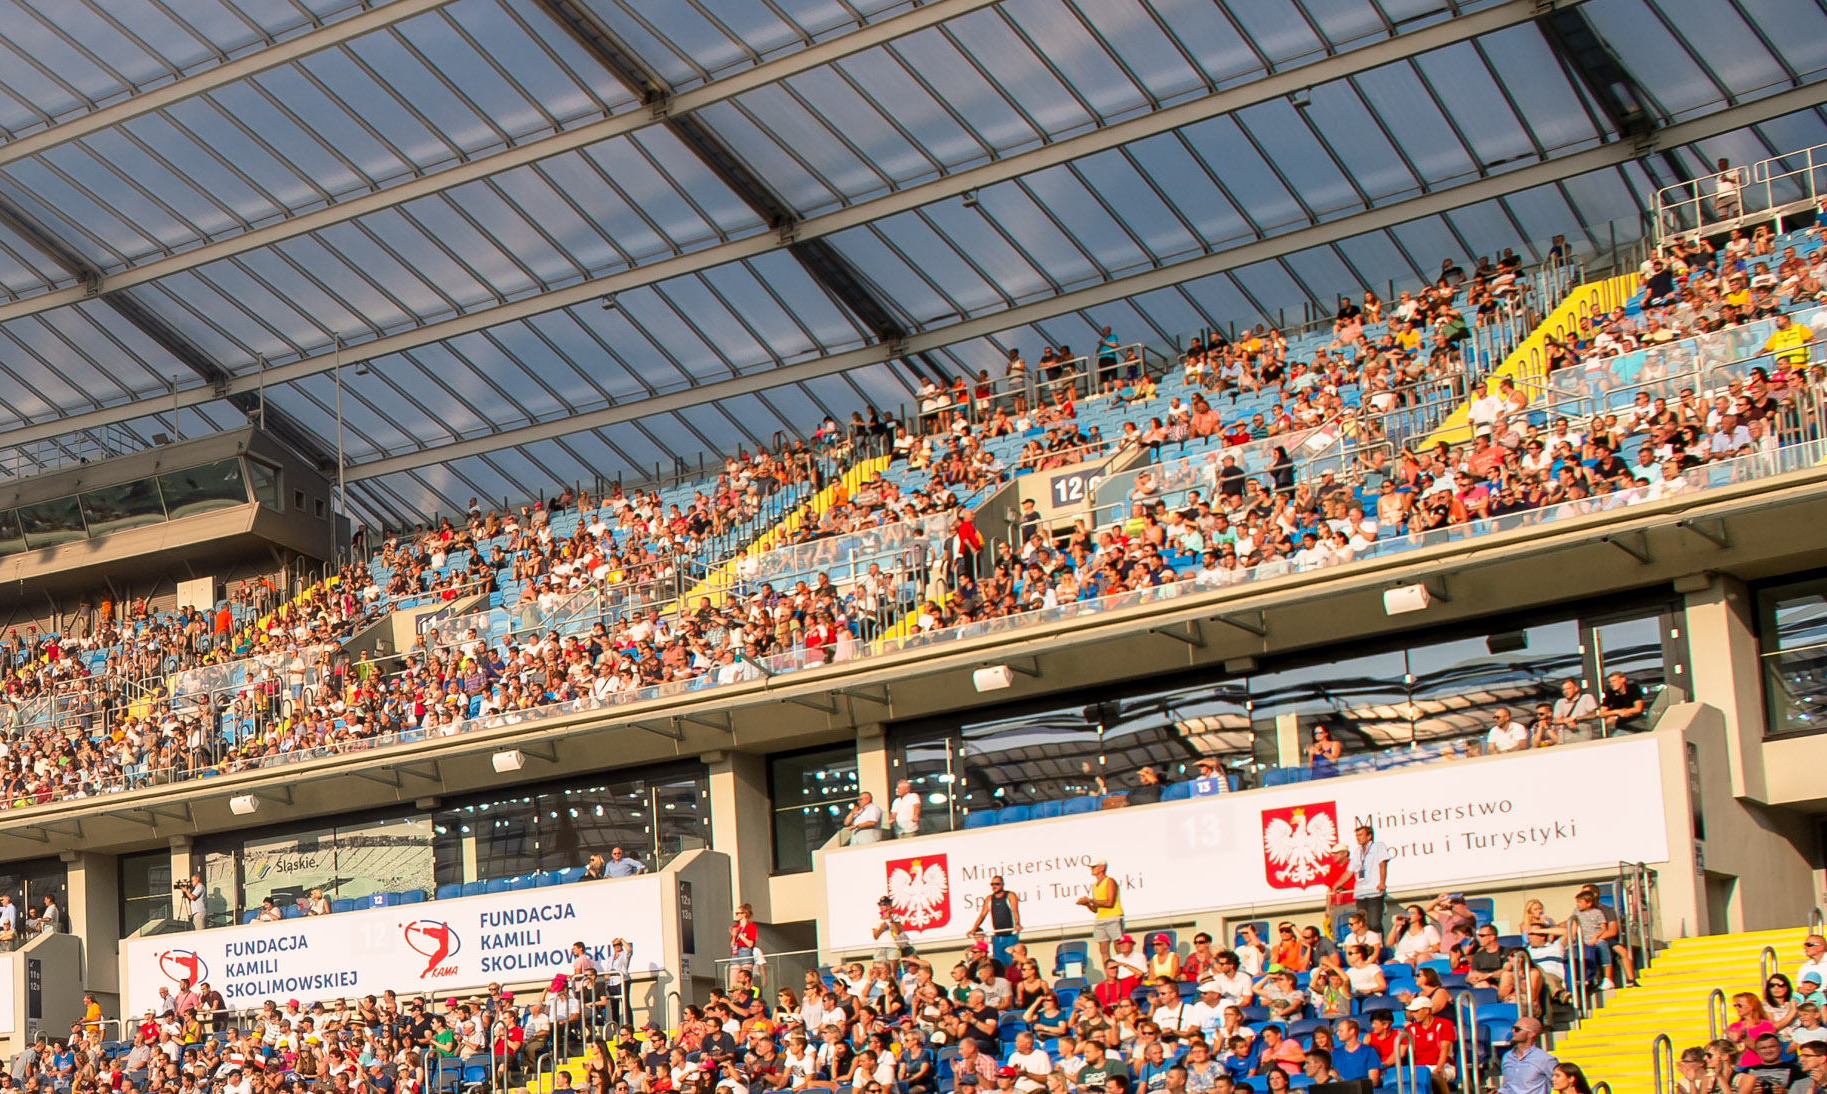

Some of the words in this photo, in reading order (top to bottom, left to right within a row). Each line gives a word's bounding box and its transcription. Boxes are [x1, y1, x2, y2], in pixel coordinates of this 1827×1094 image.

[1197, 781, 1213, 794] 13
[1354, 799, 1513, 830] Ministerstwo
[1181, 814, 1221, 849] 13
[1385, 840, 1434, 860] ortu
[1445, 835, 1451, 853] i
[1461, 819, 1578, 850] Turystyki
[276, 856, 319, 875] Śląskie.
[962, 854, 1092, 882] Ministerstwo
[373, 895, 383, 904] 12
[964, 889, 1028, 911] Spu
[1036, 884, 1042, 901] i
[480, 903, 576, 928] FUNDACJA
[225, 934, 309, 957] FUNDACJA
[480, 929, 542, 951] KAMILI
[226, 959, 279, 978] KAMILI
[481, 942, 634, 973] SKOLIMOWSKI
[226, 970, 358, 998] SKOLIMOWSKIEJ
[431, 965, 459, 978] KAMA
